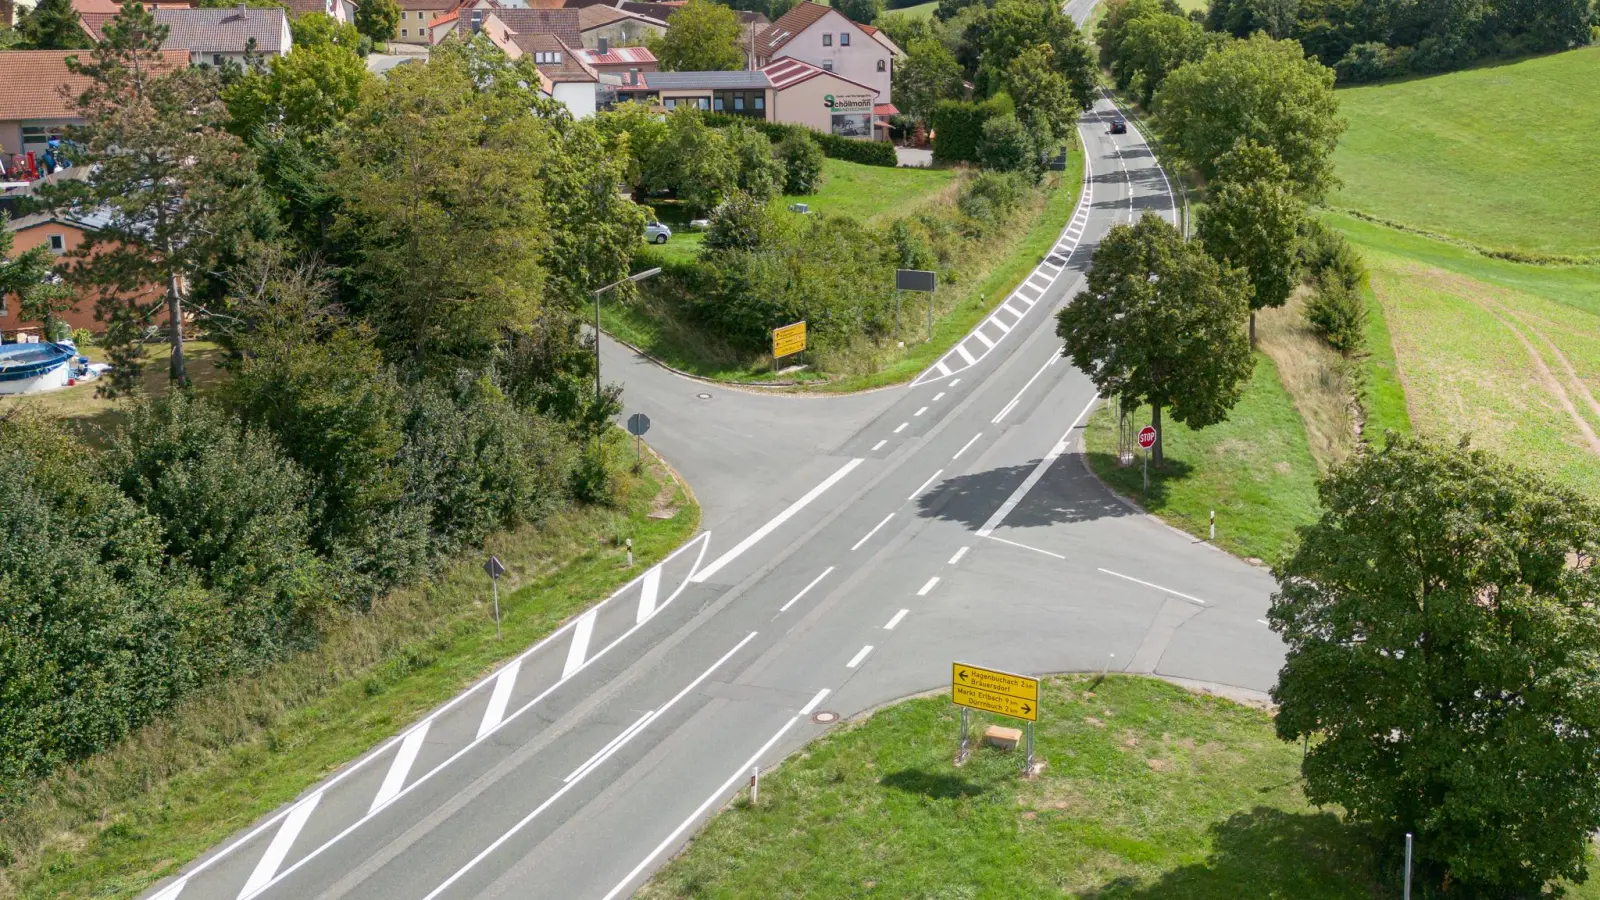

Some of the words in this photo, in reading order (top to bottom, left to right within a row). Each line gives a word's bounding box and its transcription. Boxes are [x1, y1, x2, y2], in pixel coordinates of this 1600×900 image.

[824, 94, 871, 108] Schöllmann
[1140, 432, 1154, 442] STOP
[971, 672, 1018, 686] Hagenbuchach
[971, 679, 1010, 692] Bräuersdorf
[957, 688, 976, 697] Markt
[978, 693, 1002, 702] Erlbach
